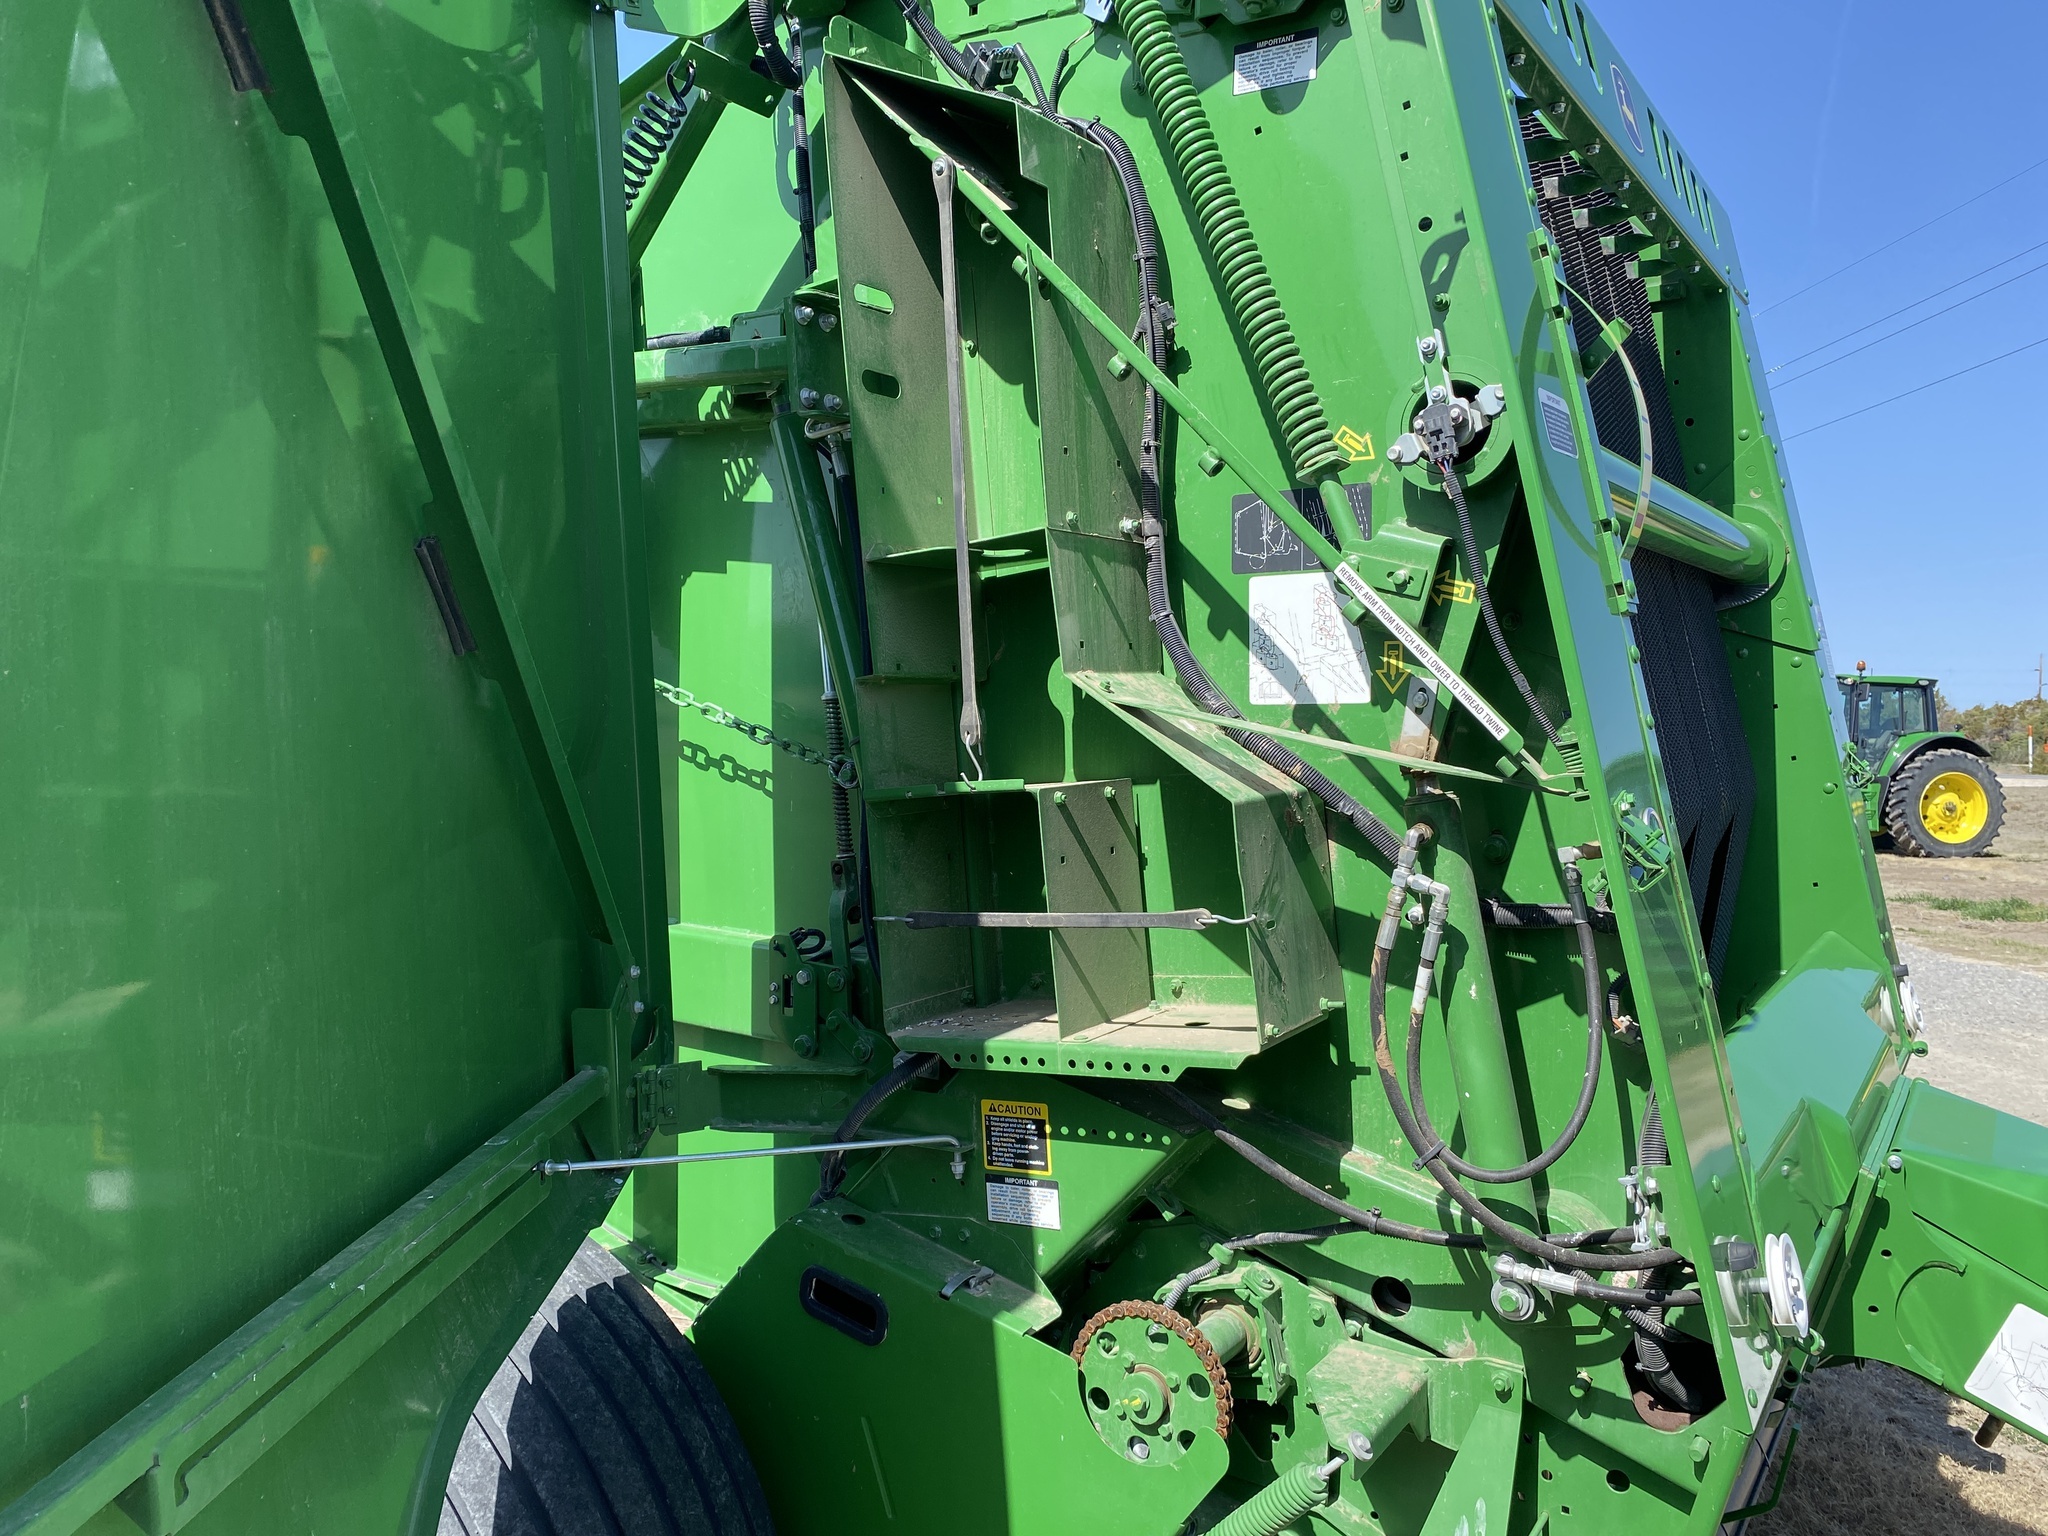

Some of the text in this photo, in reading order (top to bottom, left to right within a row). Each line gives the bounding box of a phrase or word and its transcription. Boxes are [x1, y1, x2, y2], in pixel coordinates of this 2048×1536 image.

[1257, 34, 1295, 48] IMPORTANT
[1339, 566, 1506, 736] REMOVE ARM FROM NOTCH AND LOWER TO THREAD TWINE
[998, 1104, 1041, 1116] CAUTION
[1005, 1177, 1038, 1186] IMPORTANT
